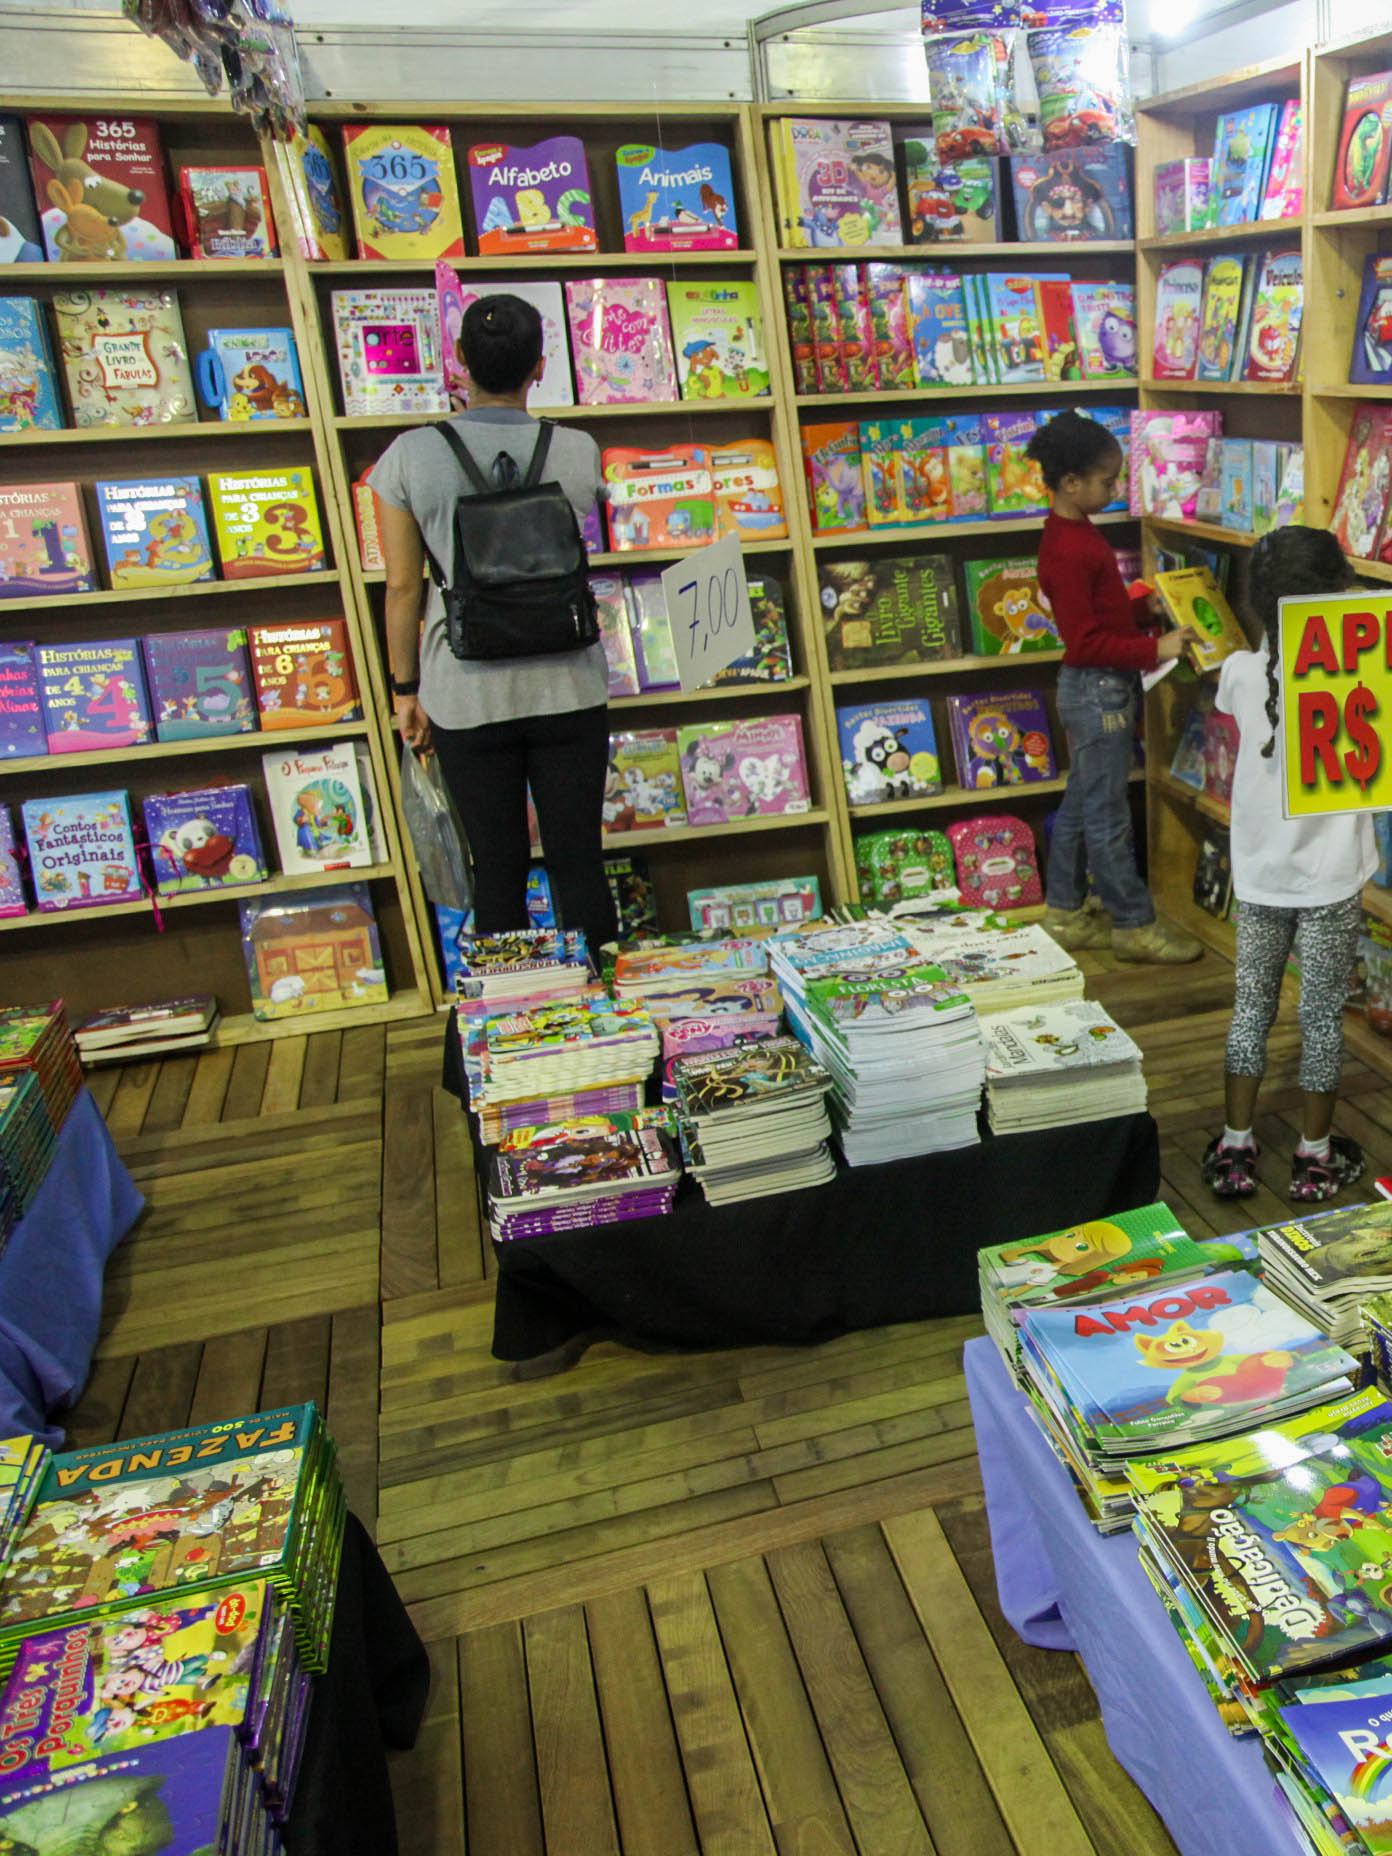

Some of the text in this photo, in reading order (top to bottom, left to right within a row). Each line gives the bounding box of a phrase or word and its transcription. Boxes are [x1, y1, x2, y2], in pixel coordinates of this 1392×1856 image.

[96, 121, 136, 138] 365
[89, 139, 146, 152] Histórias
[87, 152, 152, 163] para Sonhar
[369, 155, 427, 181] 365
[488, 161, 572, 187] Alfabeto
[638, 164, 713, 187] Animais
[816, 160, 848, 187] 3D
[103, 341, 141, 353] GRANDE
[105, 355, 136, 366] LIVRO
[218, 475, 288, 493] HISTÓRIAS
[626, 479, 695, 498] Formas
[713, 474, 755, 492] ores
[0, 490, 49, 506] TÓRIAS
[246, 489, 299, 504] CRIANÇAS
[240, 502, 261, 524] 3
[894, 568, 916, 630] Gigante
[919, 567, 947, 648] Gigantes
[678, 567, 739, 660] 7,00
[876, 596, 902, 646] Livro
[41, 647, 113, 665] HISTÓRIAS
[282, 641, 331, 655] CRIANÇAS
[43, 662, 124, 678] PARA CRIANÇAS
[276, 654, 294, 675] 6
[45, 676, 85, 696] DE 4
[48, 697, 77, 708] ANOS
[1298, 680, 1380, 792] R$
[53, 821, 98, 835] Contos
[35, 831, 124, 852] Fantásticos
[42, 849, 125, 869] Originais
[838, 975, 926, 995] FLORESTA
[1279, 1226, 1316, 1252] DINOS
[1074, 1286, 1233, 1338] AMOR
[211, 1420, 246, 1434] 500
[57, 1421, 297, 1487] FAZENDA
[1210, 1507, 1317, 1637] Dedicação
[37, 1628, 90, 1757] Porquinhos
[0, 1686, 47, 1772] Os Três
[1368, 1717, 1380, 1728] O
